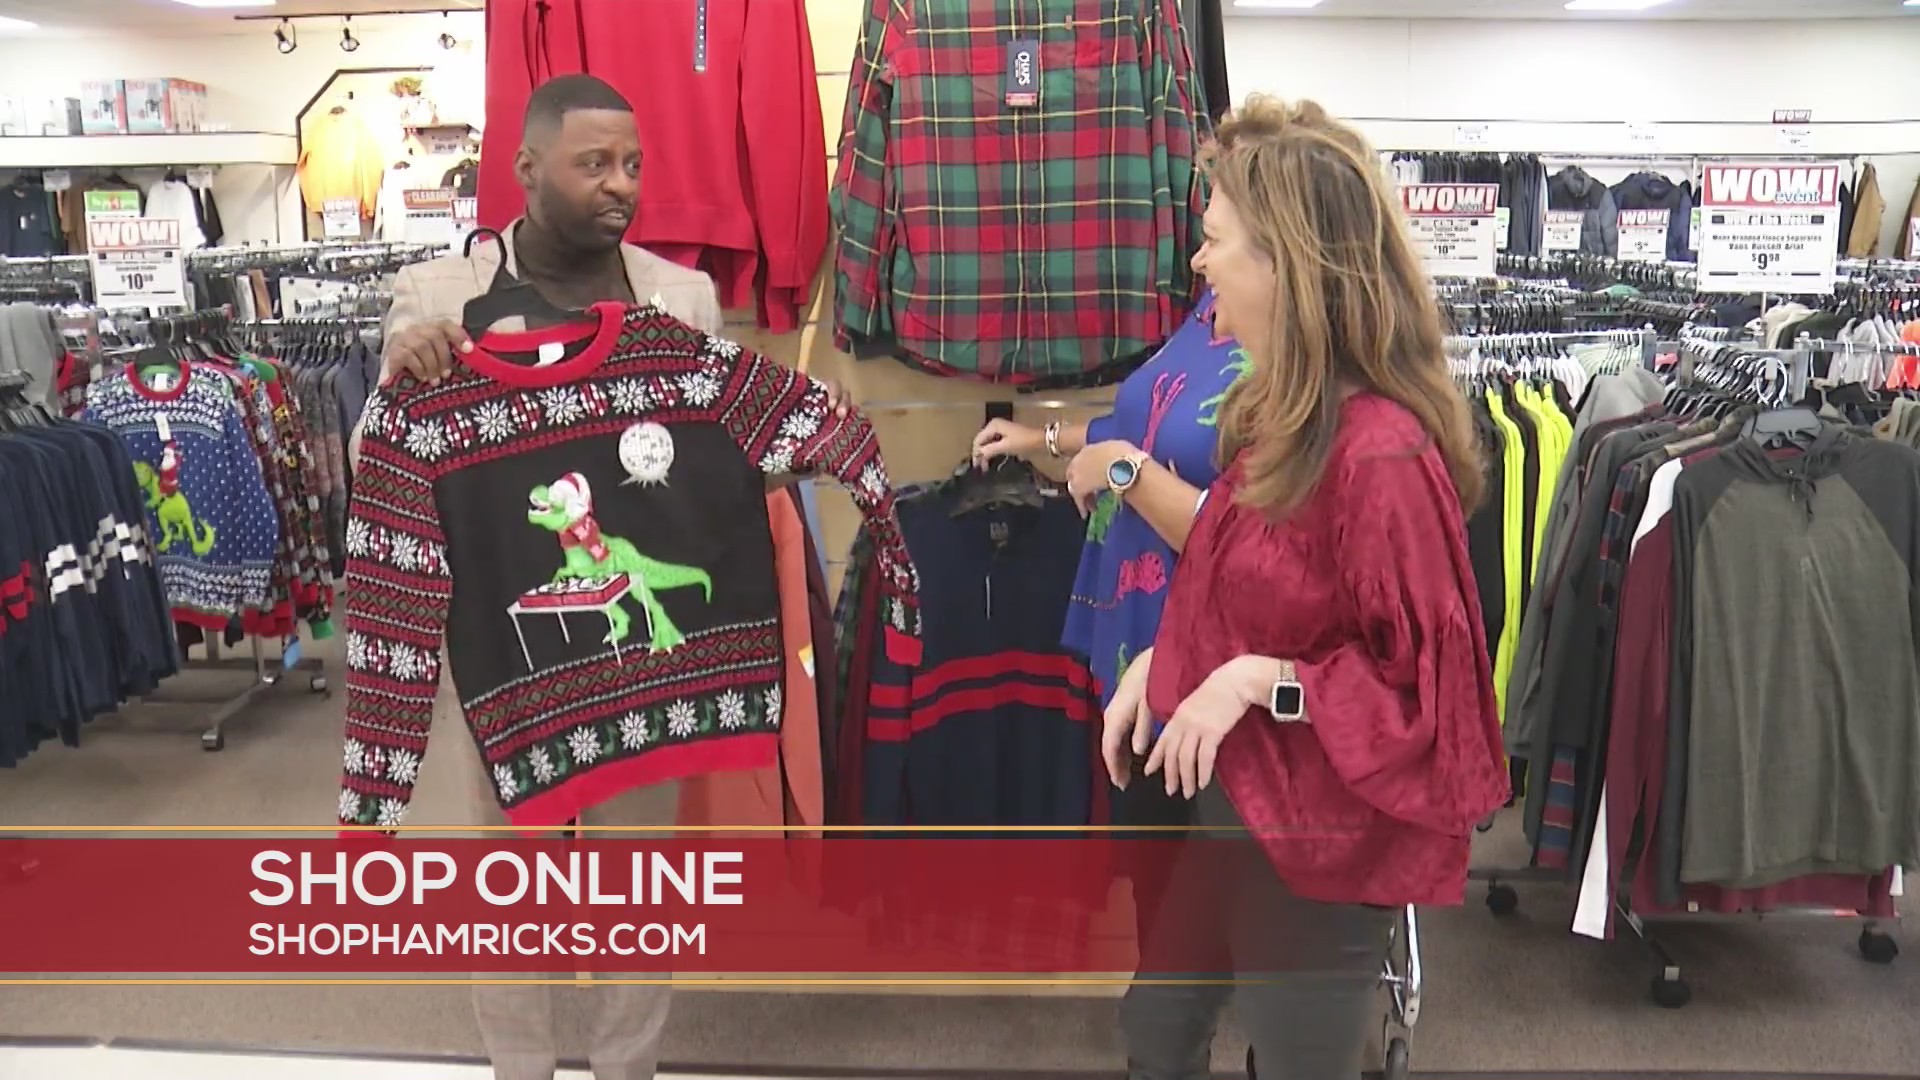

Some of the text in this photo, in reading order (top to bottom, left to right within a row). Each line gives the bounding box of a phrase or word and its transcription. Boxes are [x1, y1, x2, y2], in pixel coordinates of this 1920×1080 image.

[1018, 51, 1031, 86] CHAPS
[1709, 168, 1836, 202] WOW!
[1775, 190, 1818, 202] event
[1408, 187, 1496, 211] WOW!
[1622, 211, 1669, 225] WOW!
[91, 221, 179, 247] WOW!
